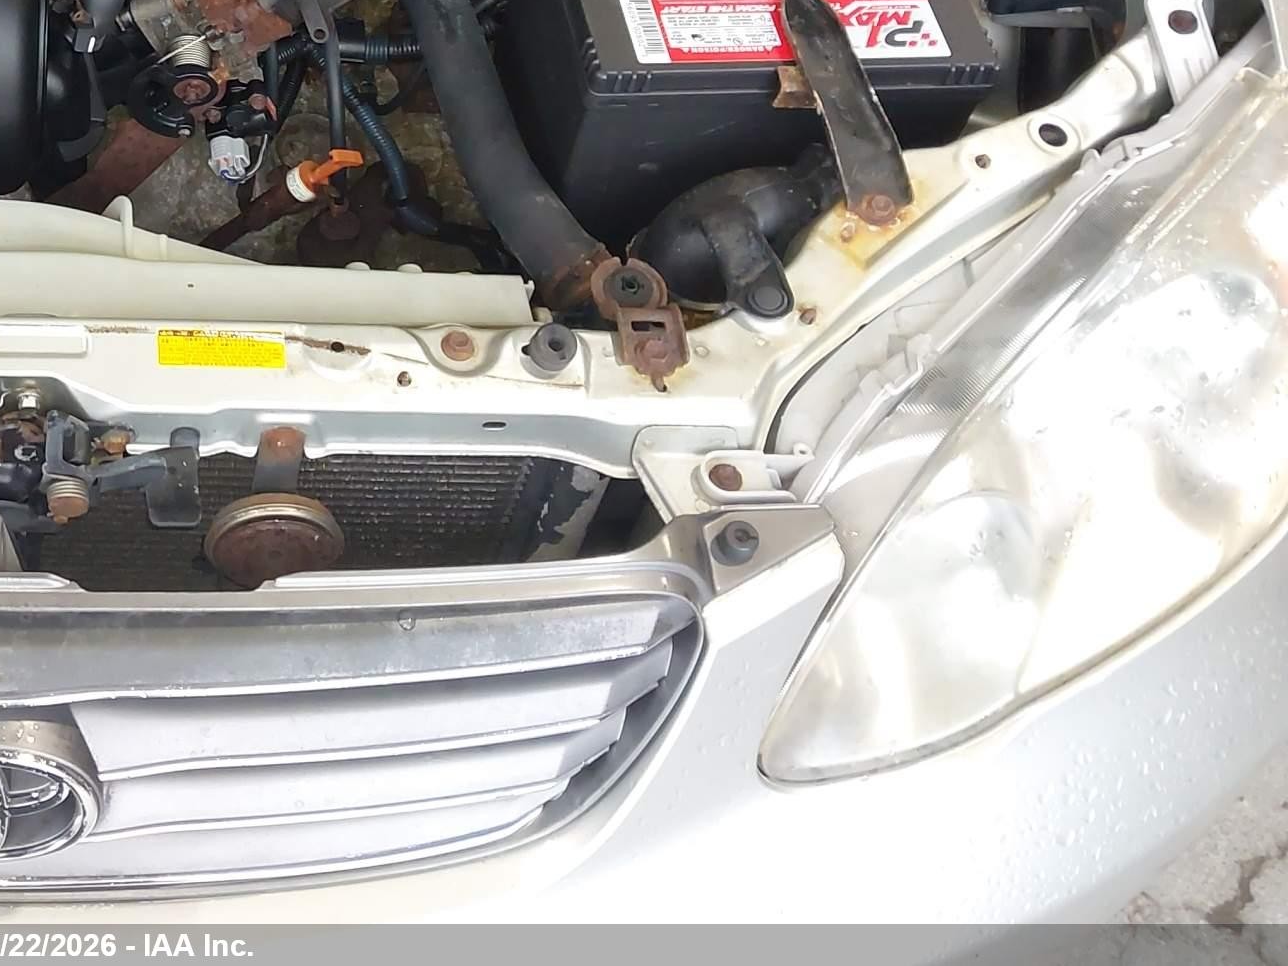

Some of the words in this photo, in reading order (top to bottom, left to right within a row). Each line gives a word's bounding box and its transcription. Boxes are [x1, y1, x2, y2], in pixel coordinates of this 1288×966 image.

[660, 4, 707, 14] START
[708, 3, 734, 13] THE
[735, 4, 777, 13] FROM
[865, 20, 925, 47] P1
